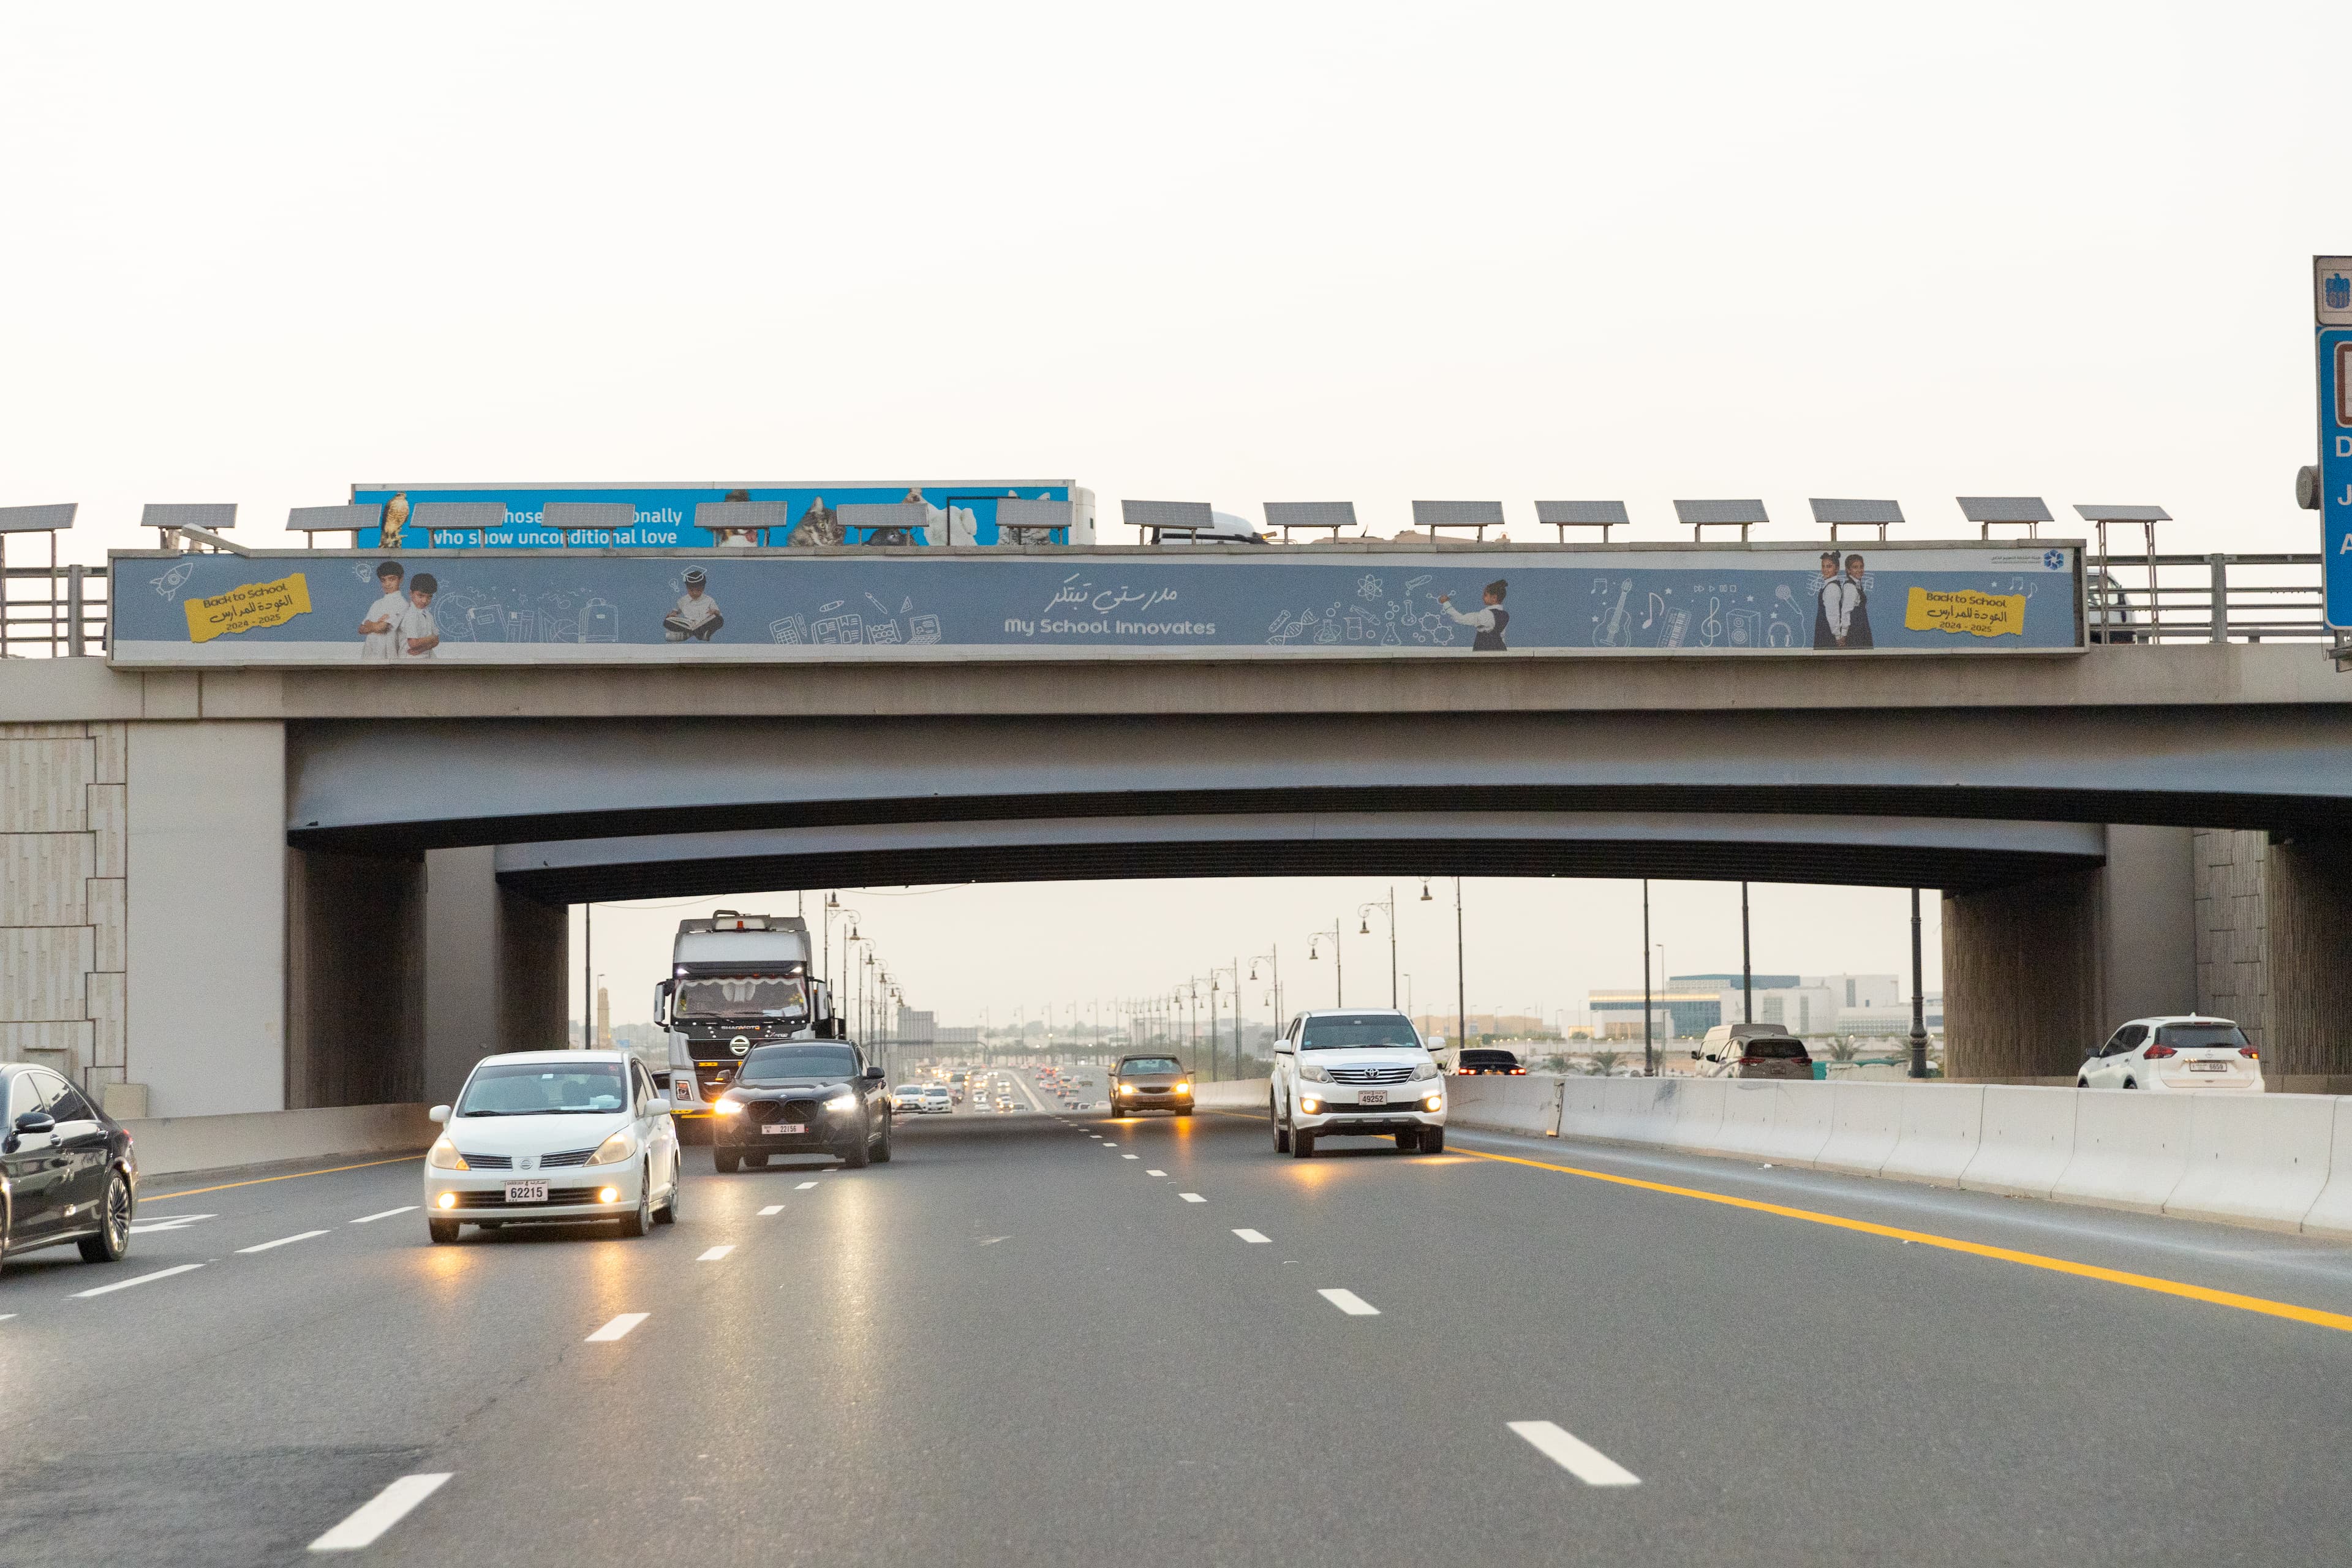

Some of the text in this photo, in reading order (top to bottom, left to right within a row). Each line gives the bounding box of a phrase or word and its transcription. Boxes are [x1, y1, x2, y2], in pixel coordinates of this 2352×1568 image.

[504, 508, 543, 523] hose
[433, 529, 464, 545] who
[469, 529, 513, 545] show
[641, 529, 677, 545] love
[203, 582, 288, 608] Back to School
[1044, 573, 1178, 614] مدرستي تبتكر
[1926, 592, 2007, 608] Back to School
[209, 594, 293, 624] العودة للمدارس
[1927, 605, 2007, 625] العودة للمدارس
[227, 619, 249, 631] 2024
[258, 614, 281, 625] 2025
[1005, 619, 1216, 636] My School Innovates
[1940, 621, 1962, 630] 2024
[1971, 624, 1992, 633] 2025
[511, 1186, 543, 1199] 62215
